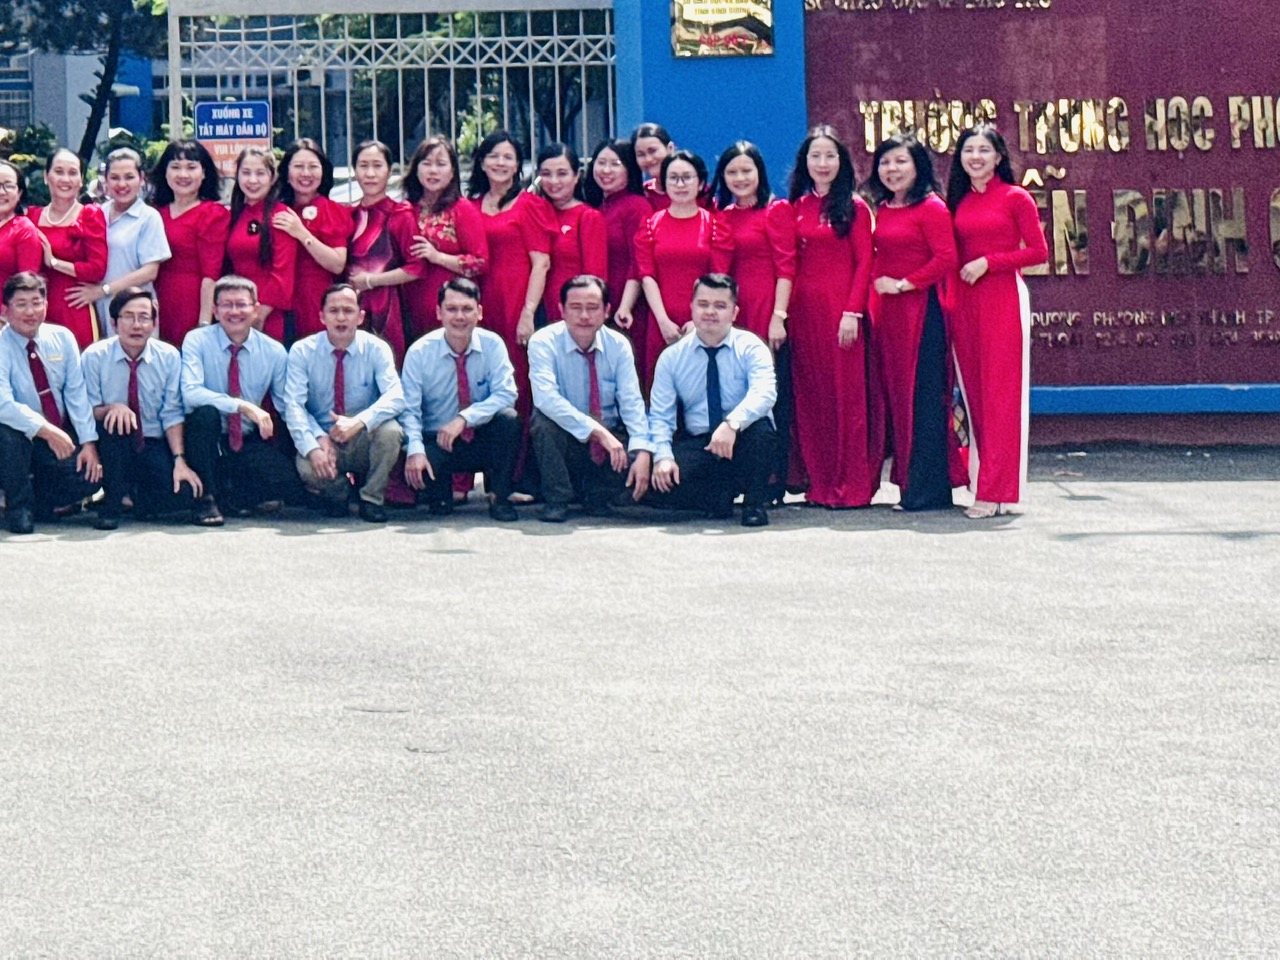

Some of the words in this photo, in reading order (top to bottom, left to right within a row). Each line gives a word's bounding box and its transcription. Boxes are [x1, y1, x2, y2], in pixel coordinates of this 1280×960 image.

[242, 108, 254, 119] XE
[1013, 96, 1130, 155] TRUNG
[1144, 95, 1215, 159] HỌC
[1228, 95, 1280, 150] PH
